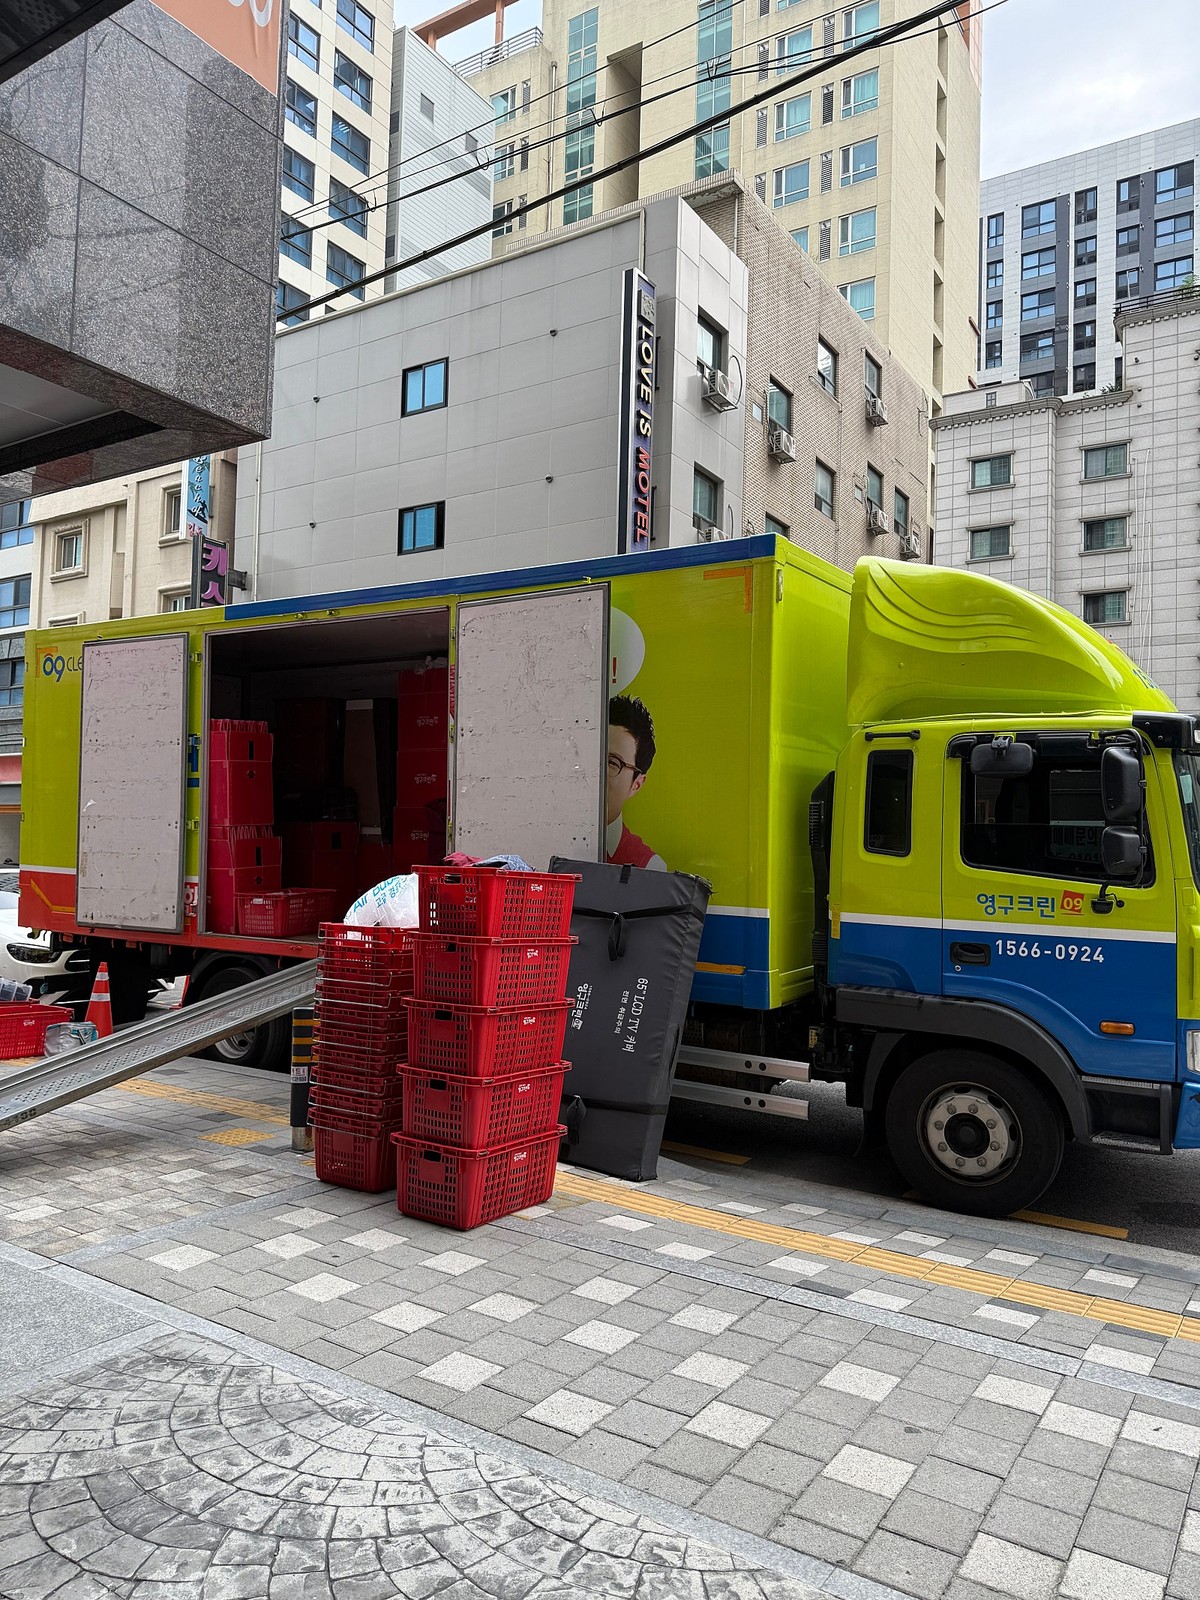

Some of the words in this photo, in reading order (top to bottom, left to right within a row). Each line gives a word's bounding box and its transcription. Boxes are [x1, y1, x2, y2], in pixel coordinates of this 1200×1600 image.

[638, 325, 654, 404] LOVE
[638, 408, 652, 437] IS
[636, 446, 651, 543] MOTEL
[976, 892, 1056, 919] 영구크린
[995, 939, 1105, 963] 1566-0924
[571, 983, 589, 1019] 영구크린
[631, 995, 645, 1016] LCD
[627, 1018, 640, 1033] TV
[621, 1034, 637, 1053] 커버
